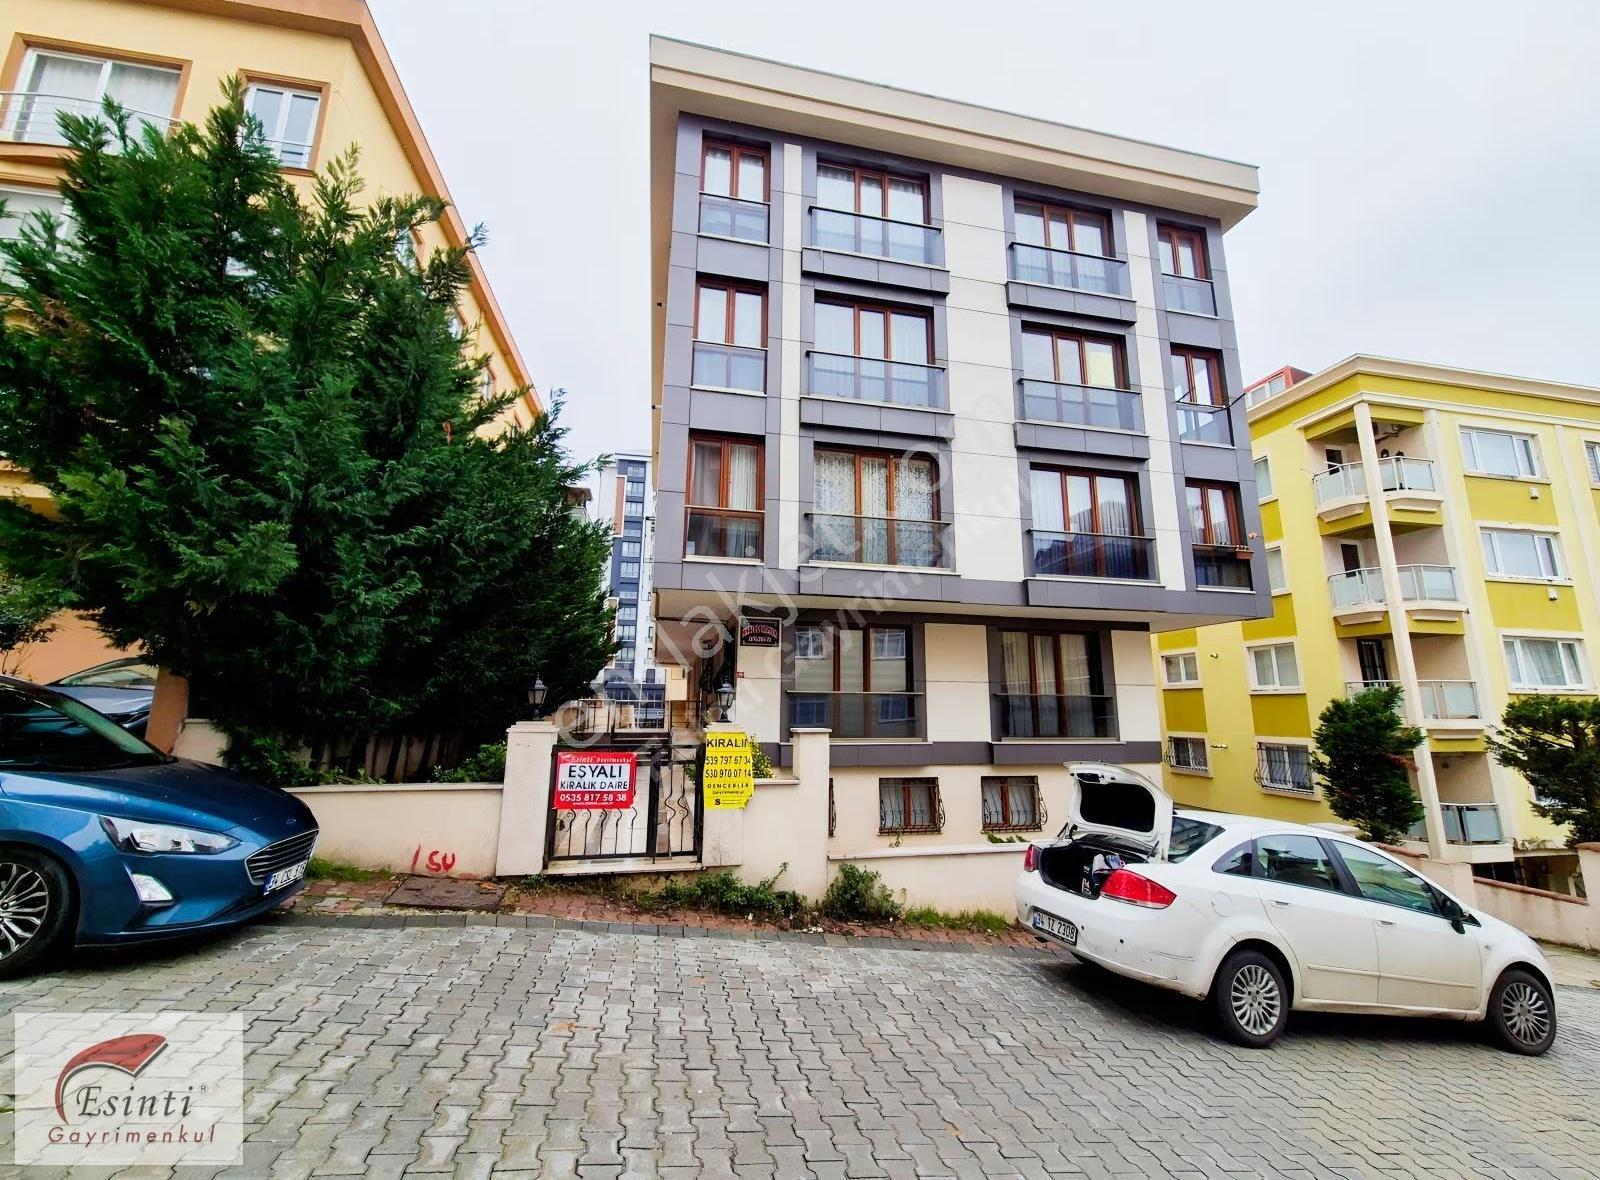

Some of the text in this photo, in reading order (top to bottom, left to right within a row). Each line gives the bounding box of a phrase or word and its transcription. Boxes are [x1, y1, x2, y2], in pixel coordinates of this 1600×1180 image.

[568, 765, 622, 780] EŞYALI
[560, 780, 628, 790] KİRALIK DAİRE
[560, 793, 627, 802] 0535 817 58 38
